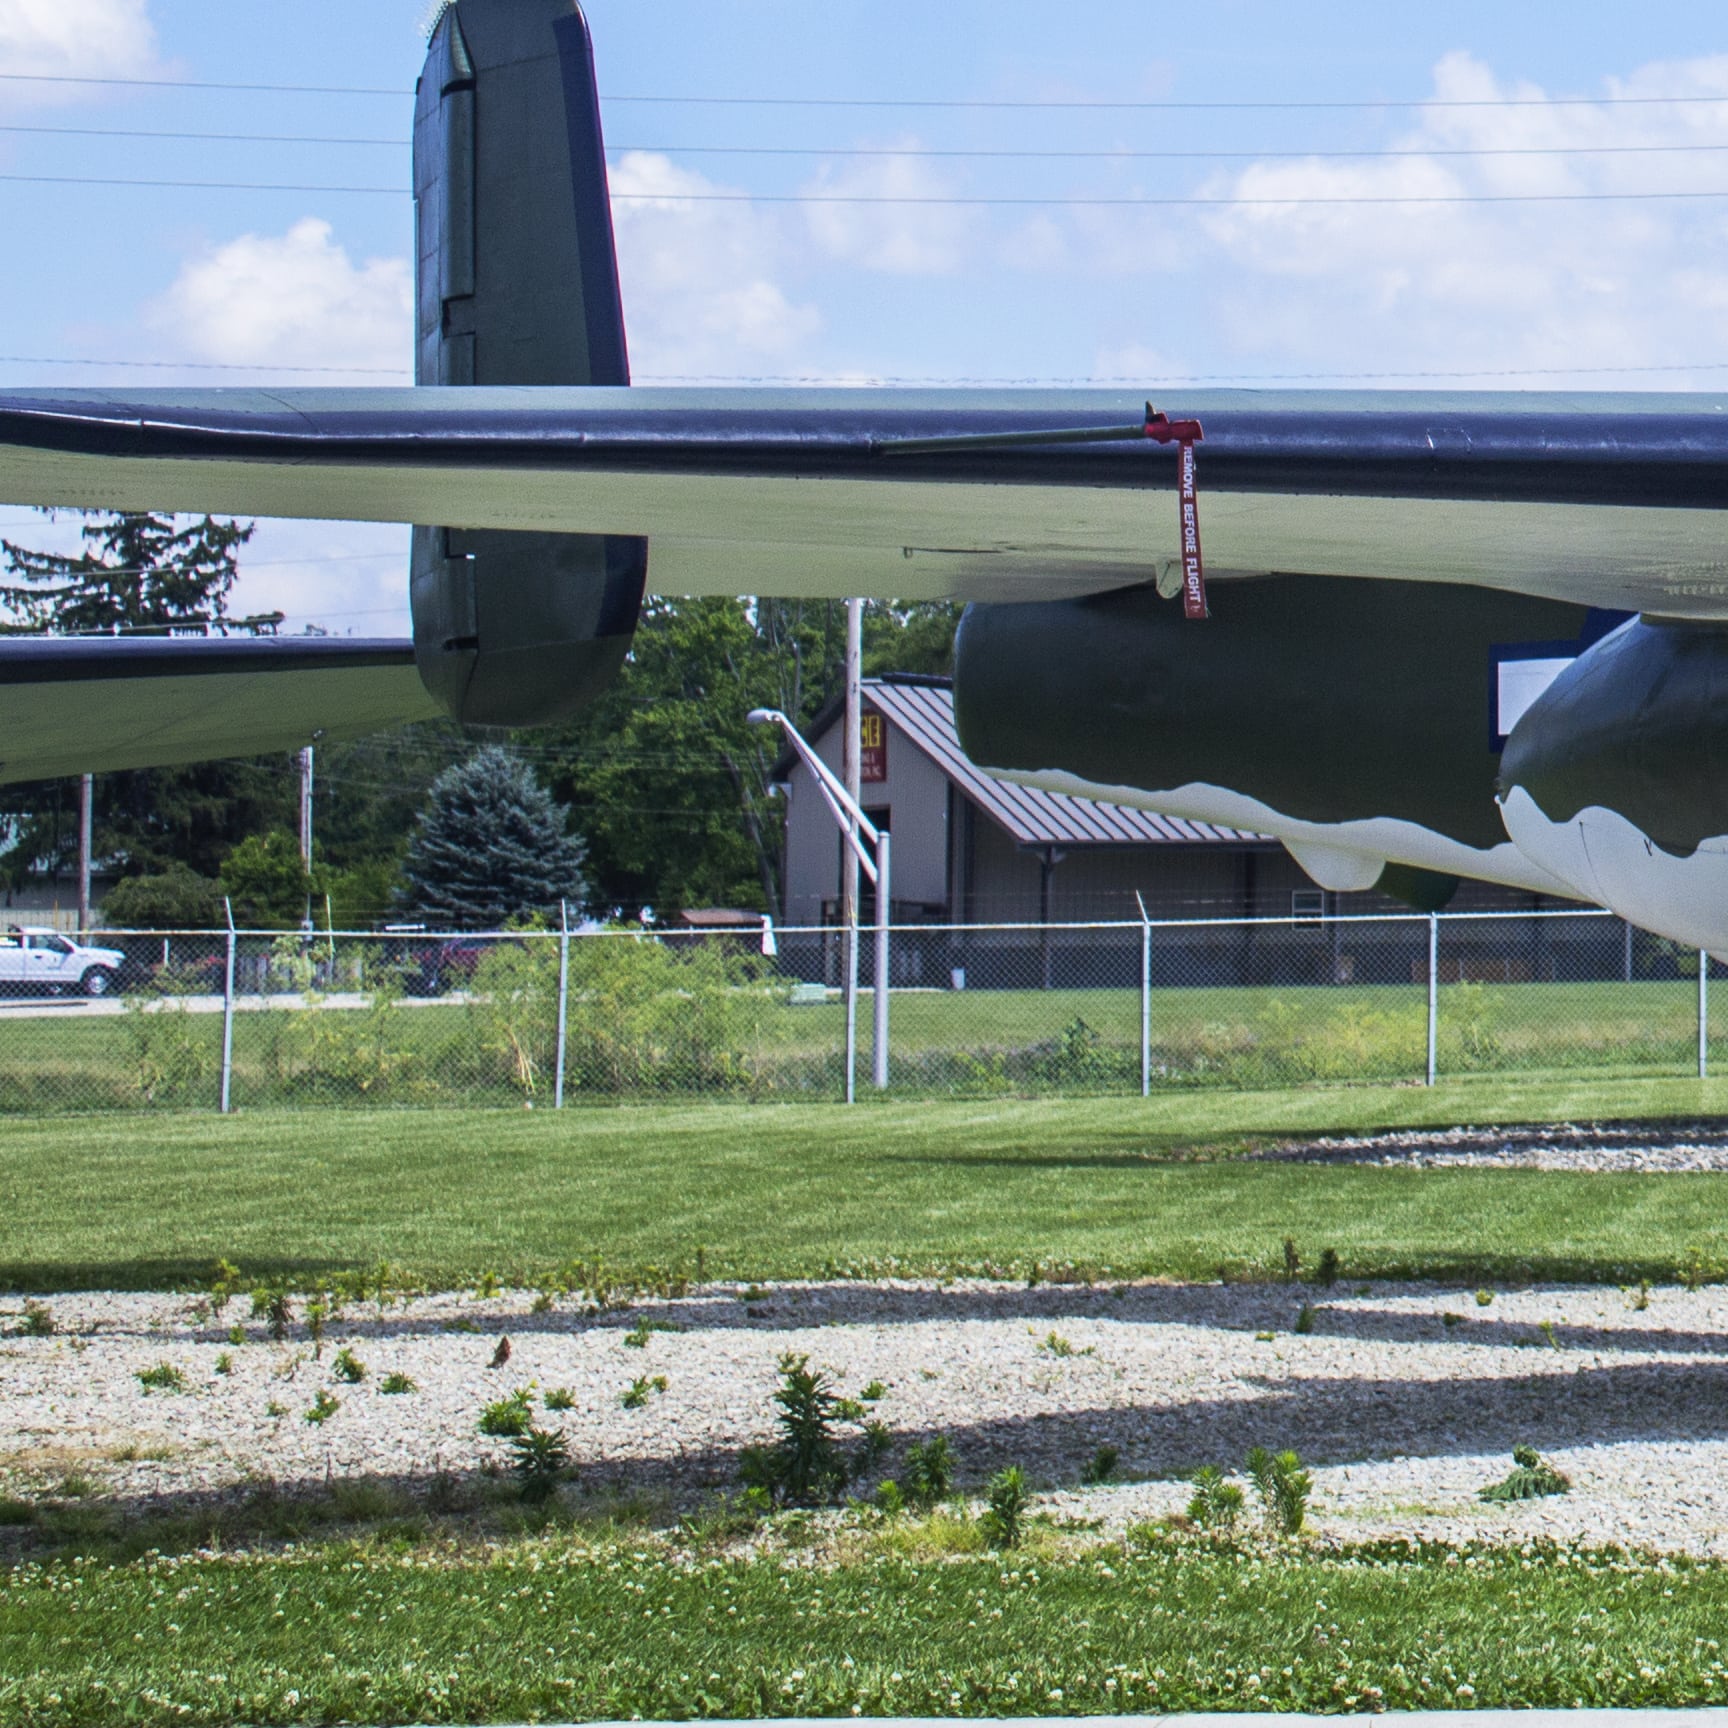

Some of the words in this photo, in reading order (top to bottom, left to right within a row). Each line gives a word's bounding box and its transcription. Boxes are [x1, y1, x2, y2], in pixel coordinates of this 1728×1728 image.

[1183, 445, 1194, 499] REMOVE
[1184, 503, 1197, 553] BEFORE
[1186, 557, 1201, 603] FLIGHT
